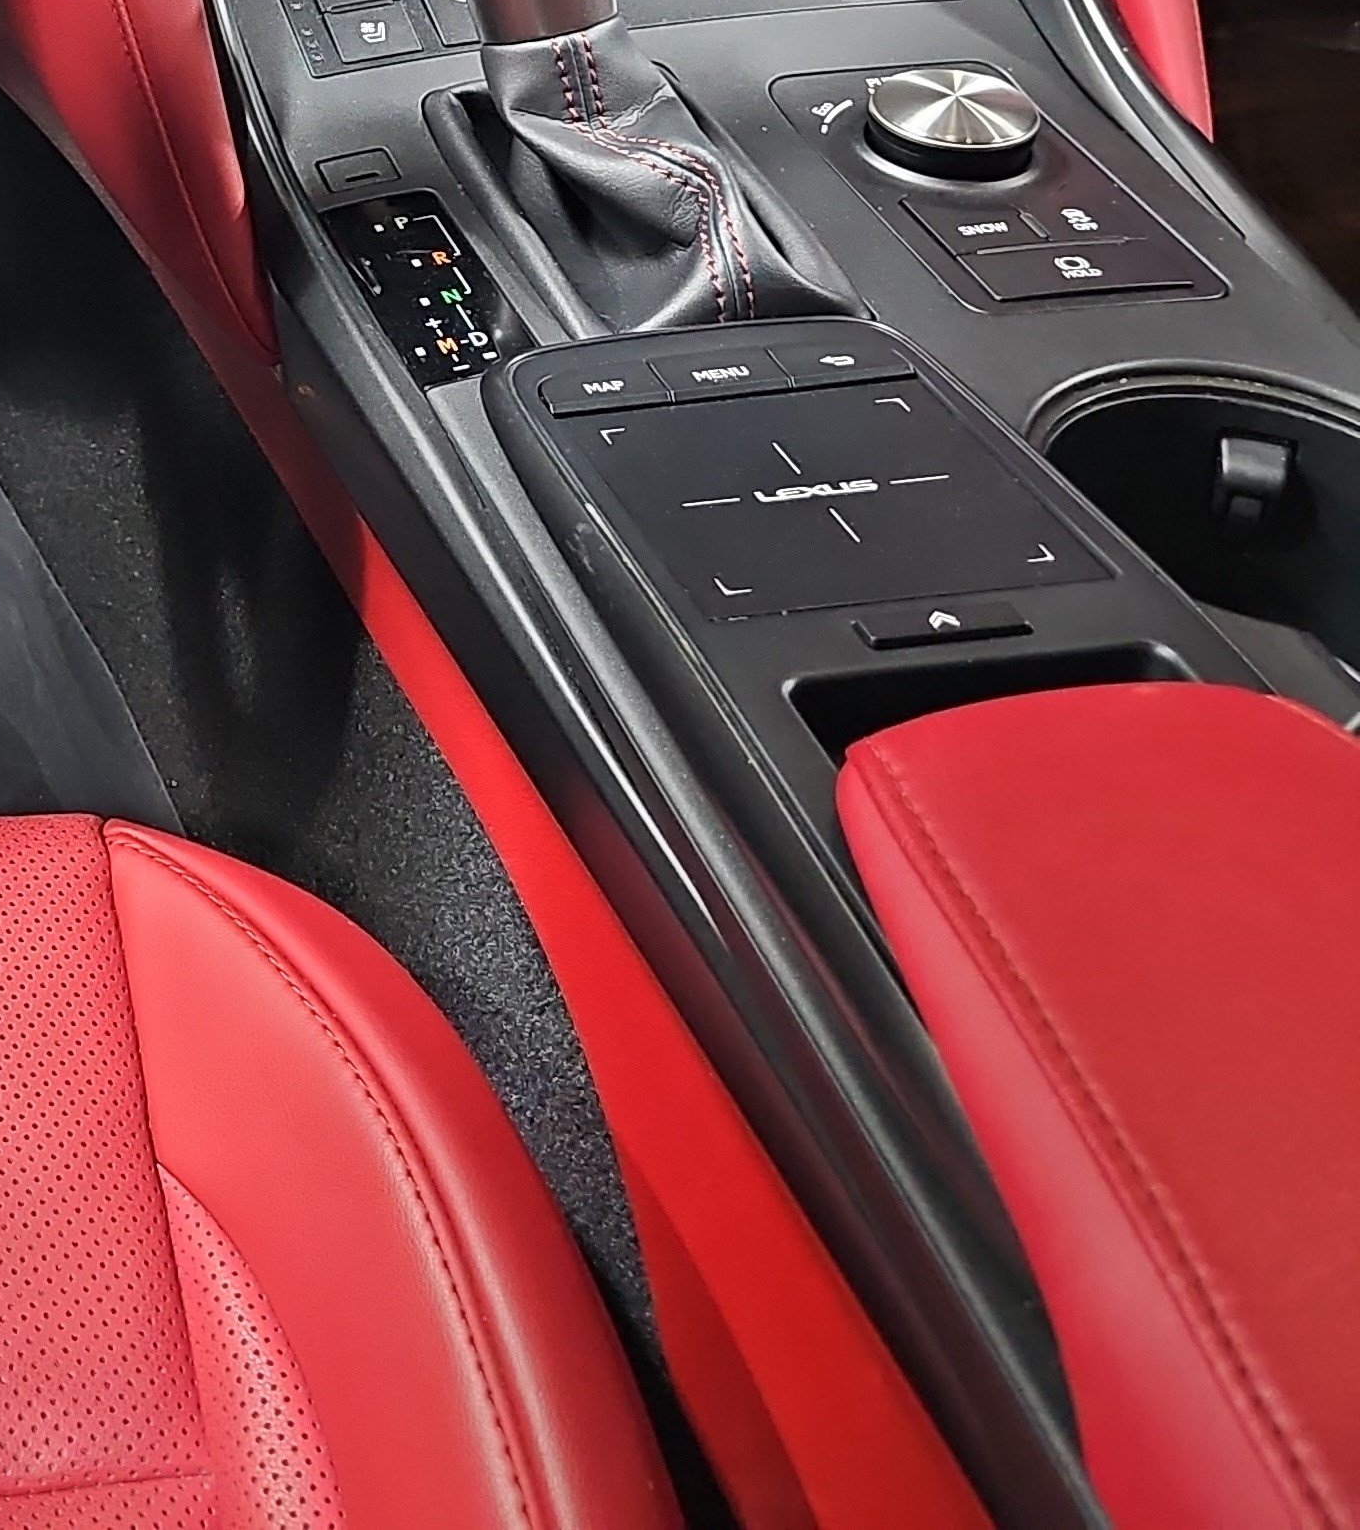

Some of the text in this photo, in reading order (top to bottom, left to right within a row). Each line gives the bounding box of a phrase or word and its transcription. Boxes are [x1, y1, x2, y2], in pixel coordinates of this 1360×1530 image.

[393, 216, 409, 230] P
[957, 221, 1009, 237] SNOW
[431, 250, 452, 265] R
[1061, 268, 1104, 280] HOLD
[440, 287, 464, 304] N
[435, 337, 459, 355] M
[467, 331, 489, 347] D
[691, 365, 751, 382] MENU
[582, 380, 625, 395] MAP
[752, 478, 880, 504] LEXUS
